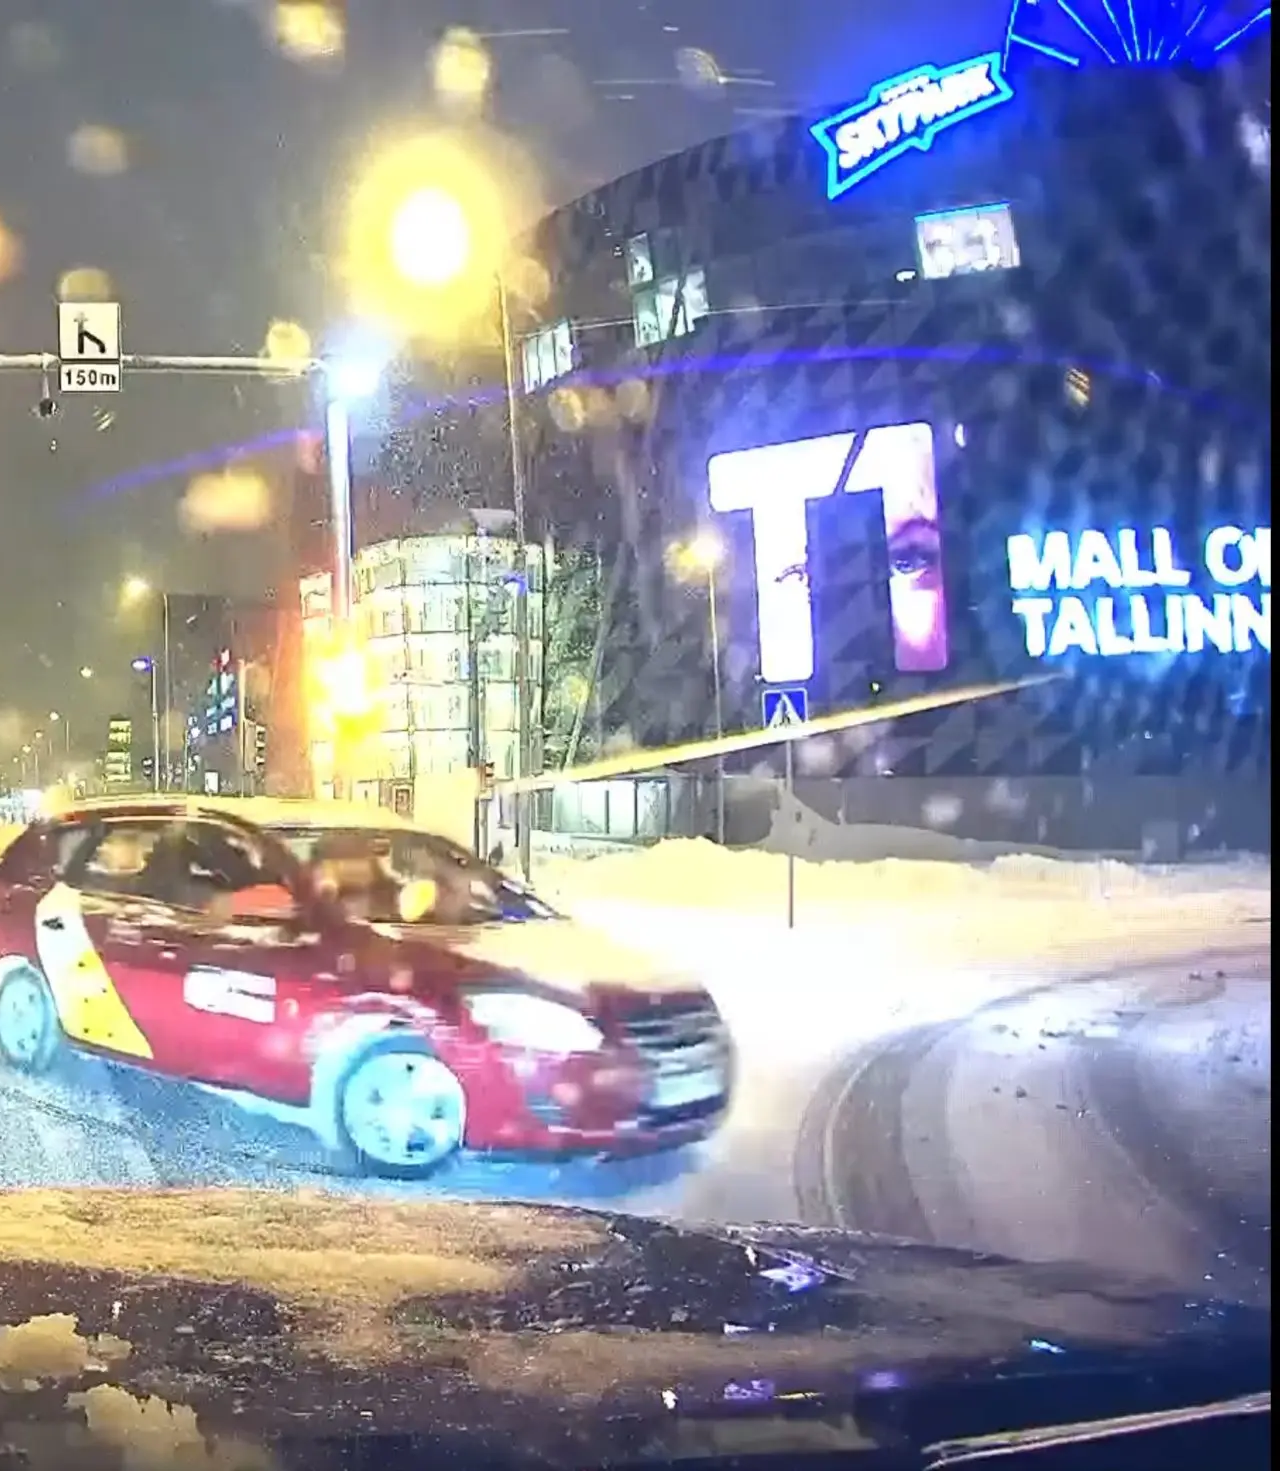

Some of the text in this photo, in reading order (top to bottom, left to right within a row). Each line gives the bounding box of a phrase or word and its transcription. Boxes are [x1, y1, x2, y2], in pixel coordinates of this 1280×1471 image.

[707, 420, 948, 683] T1
[1007, 527, 1191, 590] MALL
[1012, 593, 1272, 657] TALLINN
